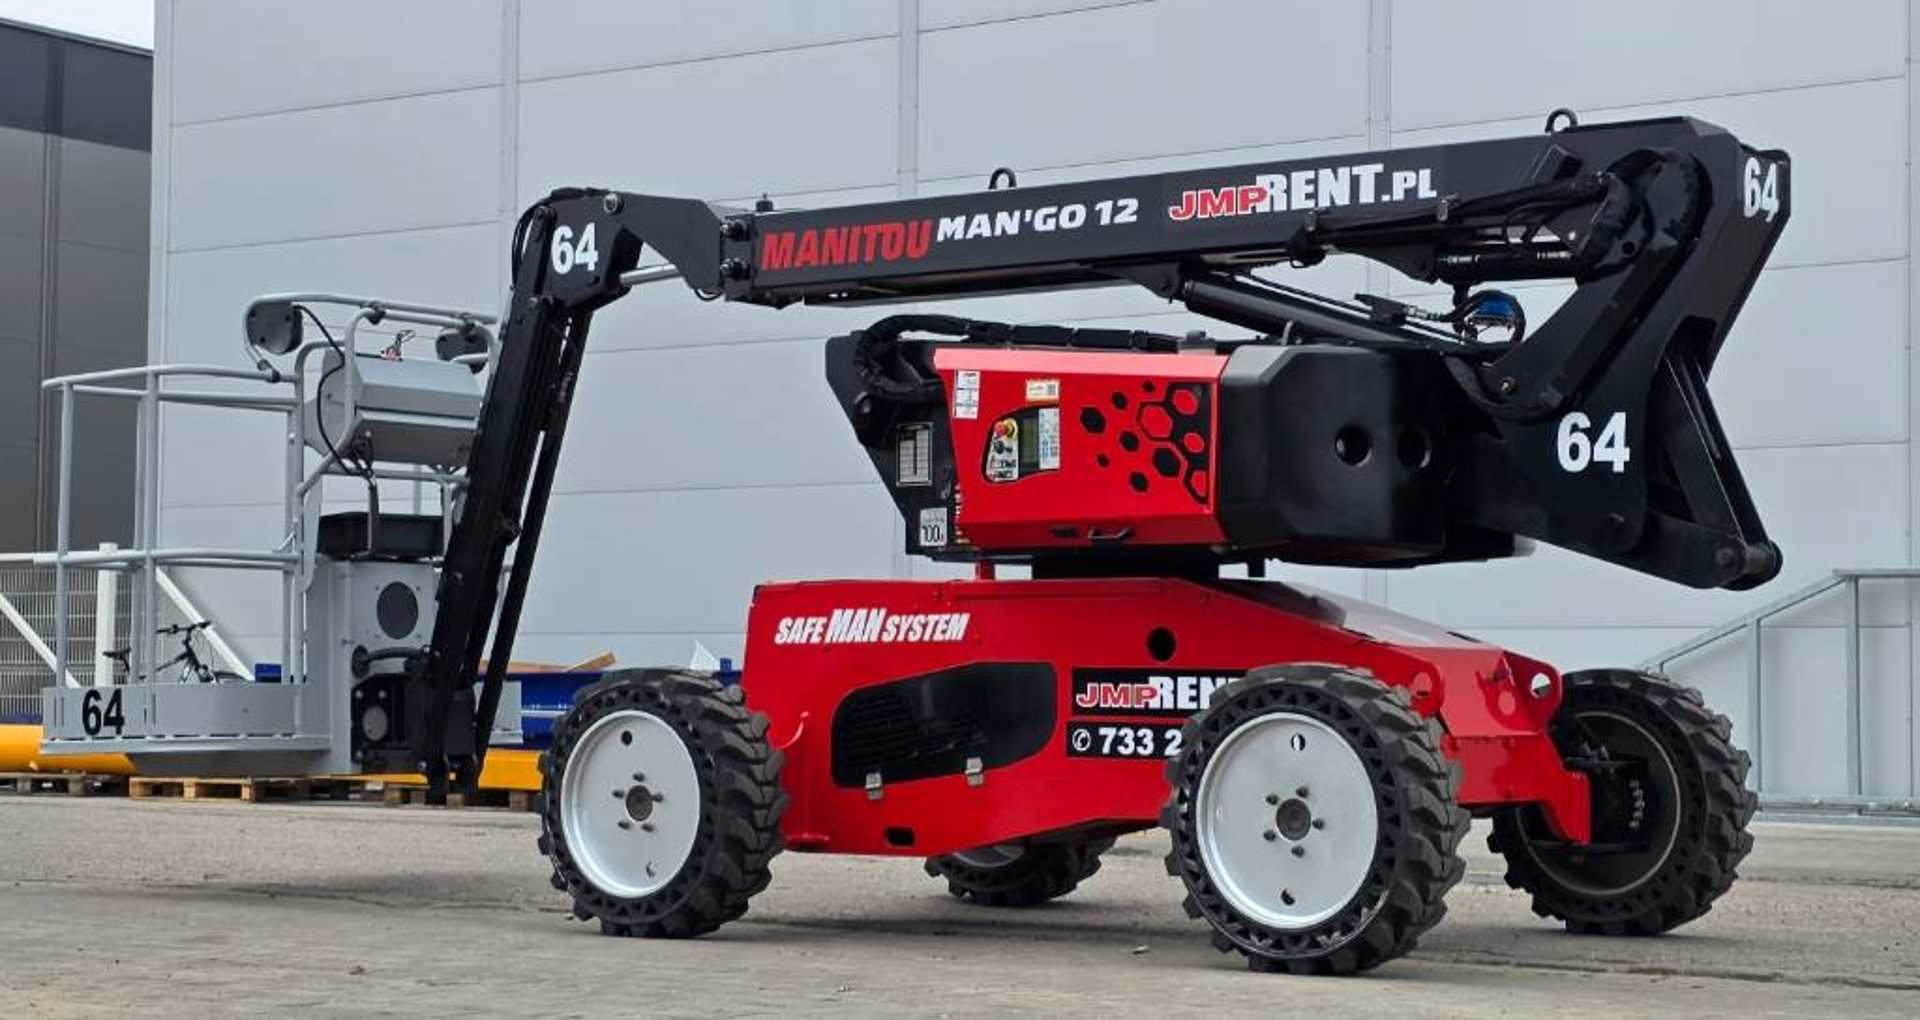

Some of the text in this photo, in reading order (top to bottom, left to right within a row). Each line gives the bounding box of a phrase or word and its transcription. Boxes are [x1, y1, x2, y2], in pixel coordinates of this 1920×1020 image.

[1743, 157, 1780, 223] 64
[550, 222, 599, 275] 64
[761, 197, 1140, 271] MANITOU MAN'GO 12
[1557, 411, 1631, 473] 64
[774, 607, 971, 645] SAFE MAN SYSTEM
[82, 688, 125, 736] 64
[1075, 675, 1242, 710] JMPREN
[1098, 726, 1154, 756] 733
